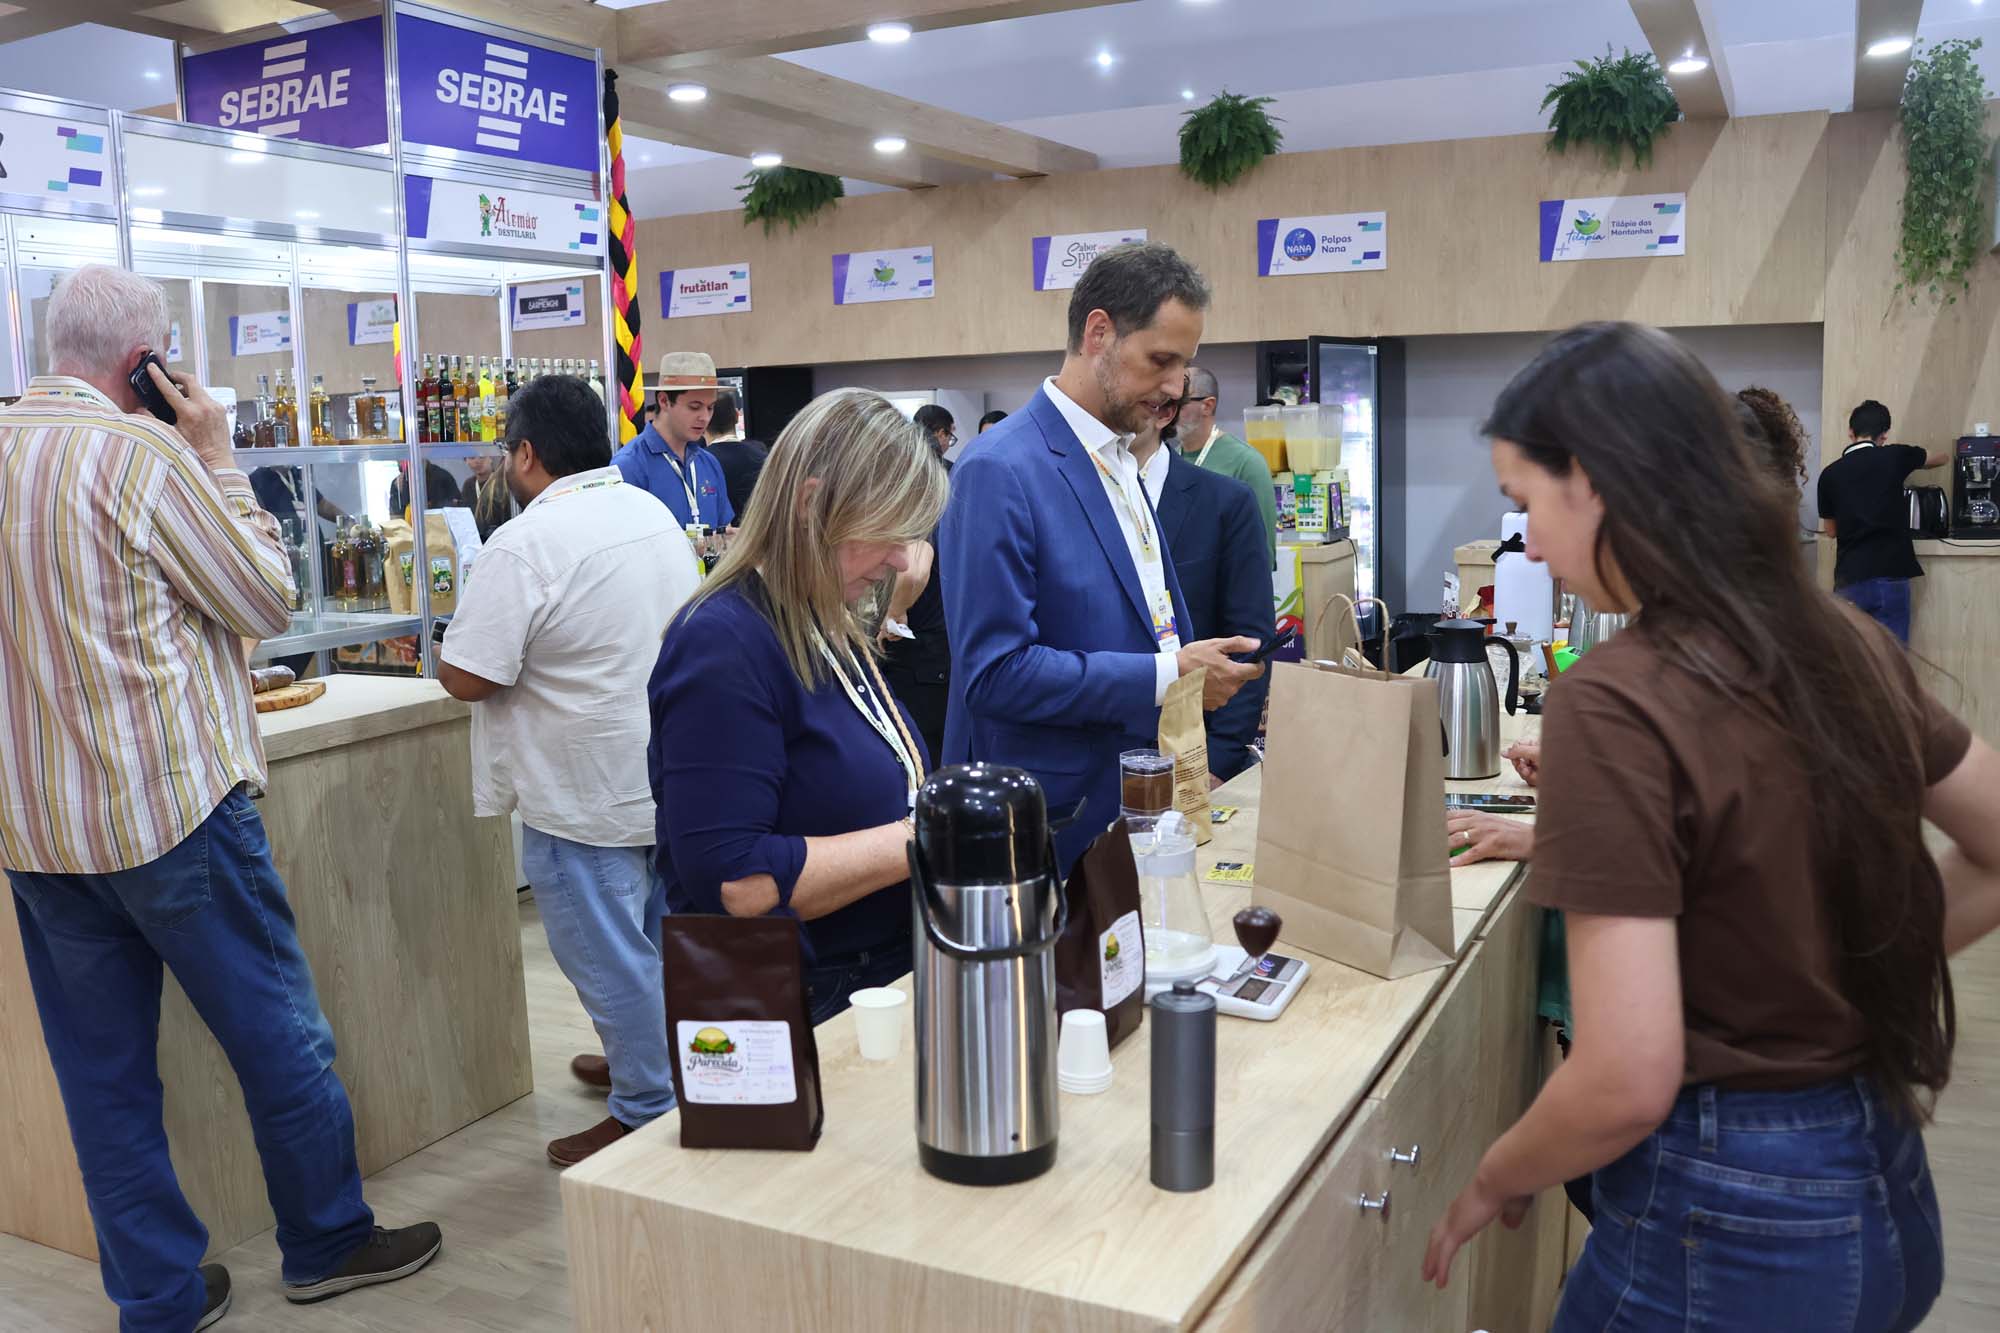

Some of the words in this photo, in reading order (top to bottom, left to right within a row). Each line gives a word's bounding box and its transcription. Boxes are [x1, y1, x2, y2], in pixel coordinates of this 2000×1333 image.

[218, 67, 351, 127] SEBRAE
[435, 68, 568, 126] SEBRAE
[1638, 219, 1652, 227] das
[497, 227, 537, 240] DESTILARIA
[1321, 235, 1352, 245] Polpas
[1286, 244, 1312, 254] NANA
[1321, 245, 1346, 253] Nana
